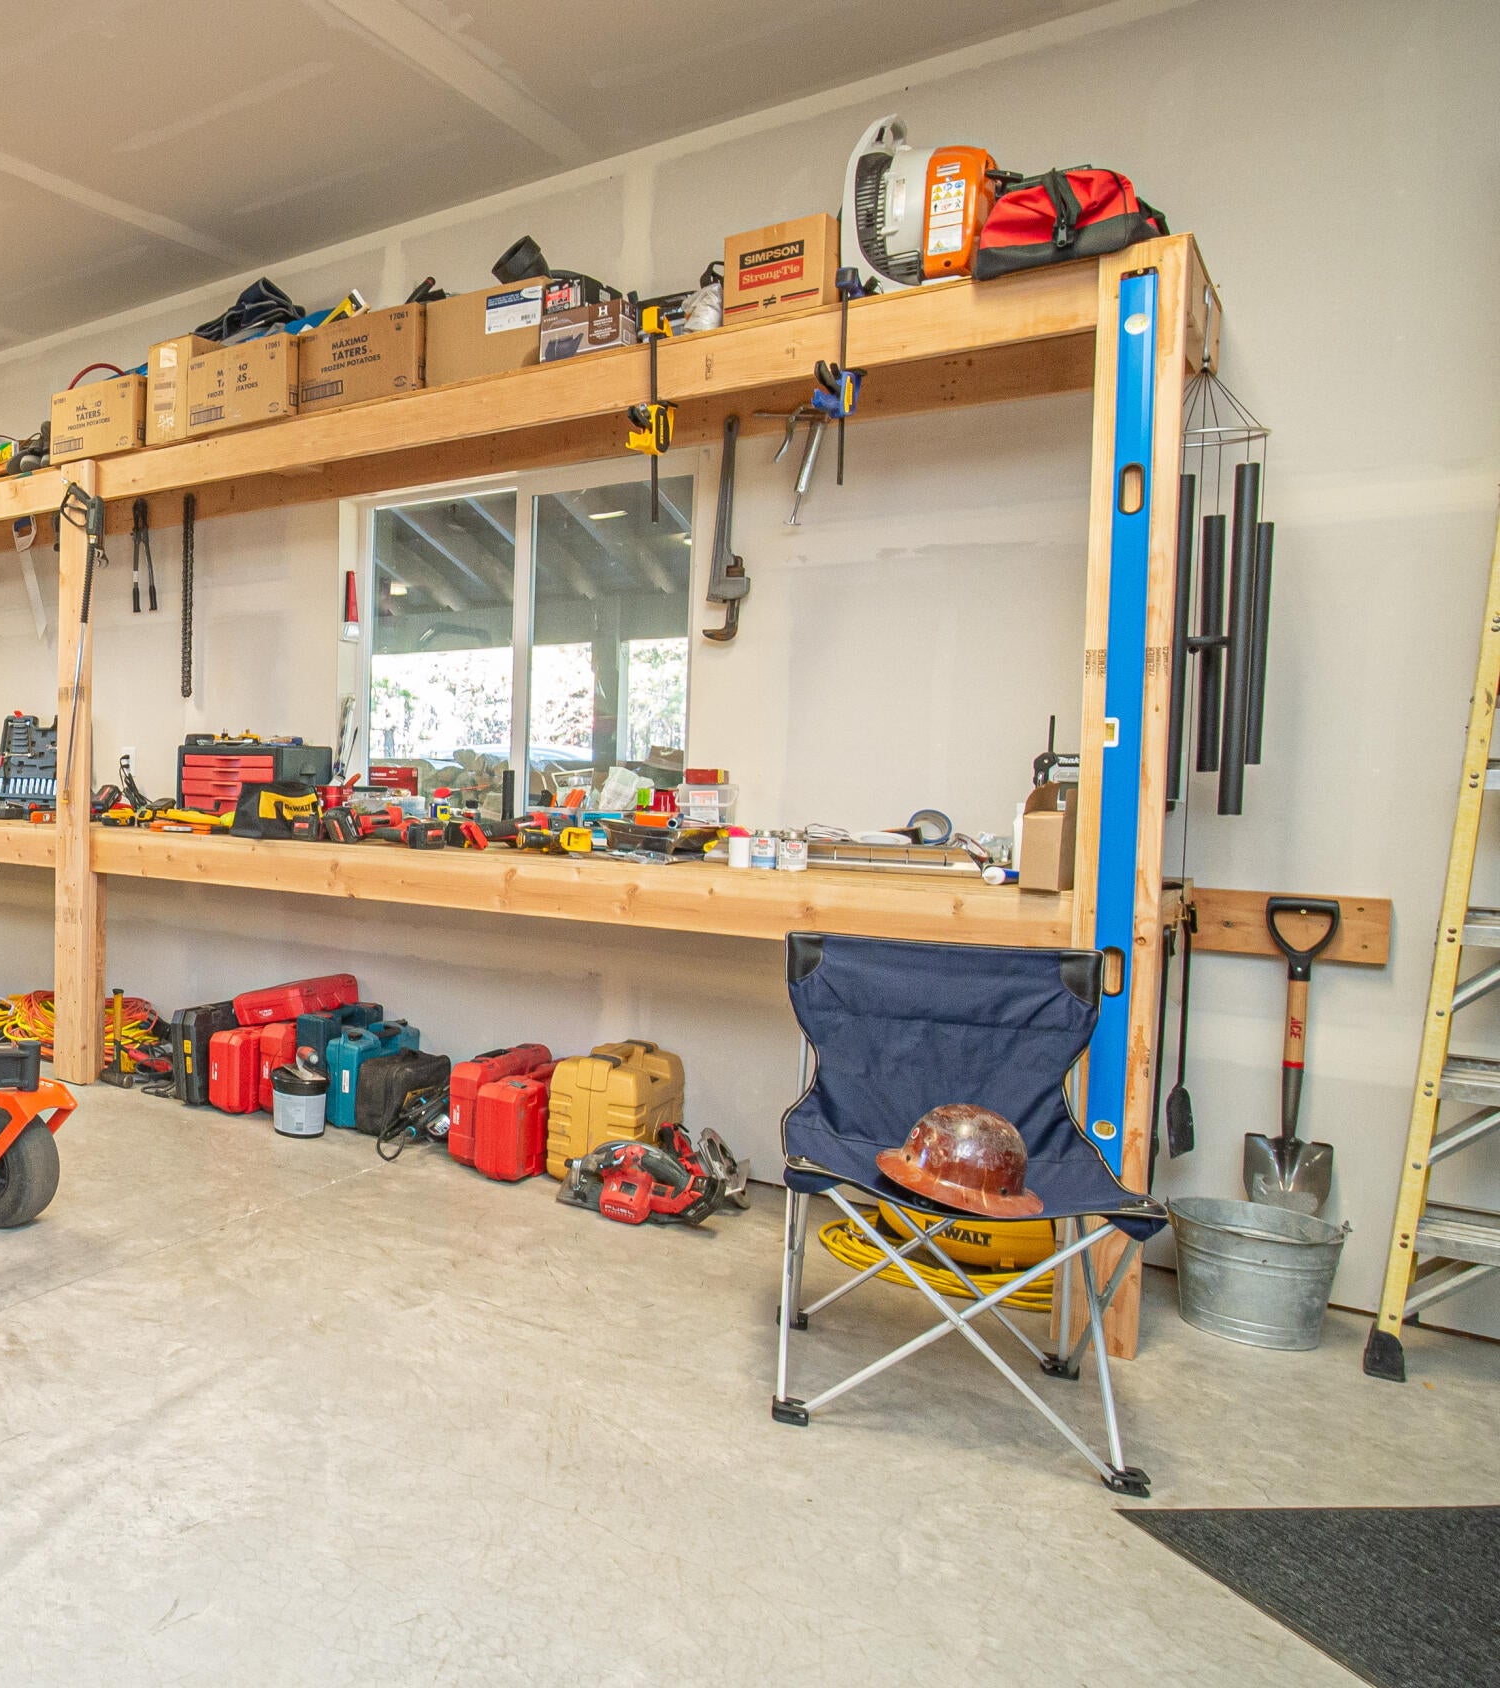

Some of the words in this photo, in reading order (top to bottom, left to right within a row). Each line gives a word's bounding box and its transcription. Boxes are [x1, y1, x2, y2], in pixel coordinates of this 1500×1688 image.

[744, 244, 799, 265] SIMPSON
[332, 345, 368, 361] TATERS
[321, 363, 345, 374] FROZEN
[346, 354, 381, 367] POTATOES
[76, 409, 102, 422] TATERS
[1058, 756, 1079, 764] Mak
[1290, 1016, 1303, 1040] ACE
[604, 1203, 634, 1215] FUEL
[925, 1220, 992, 1247] DWALT
